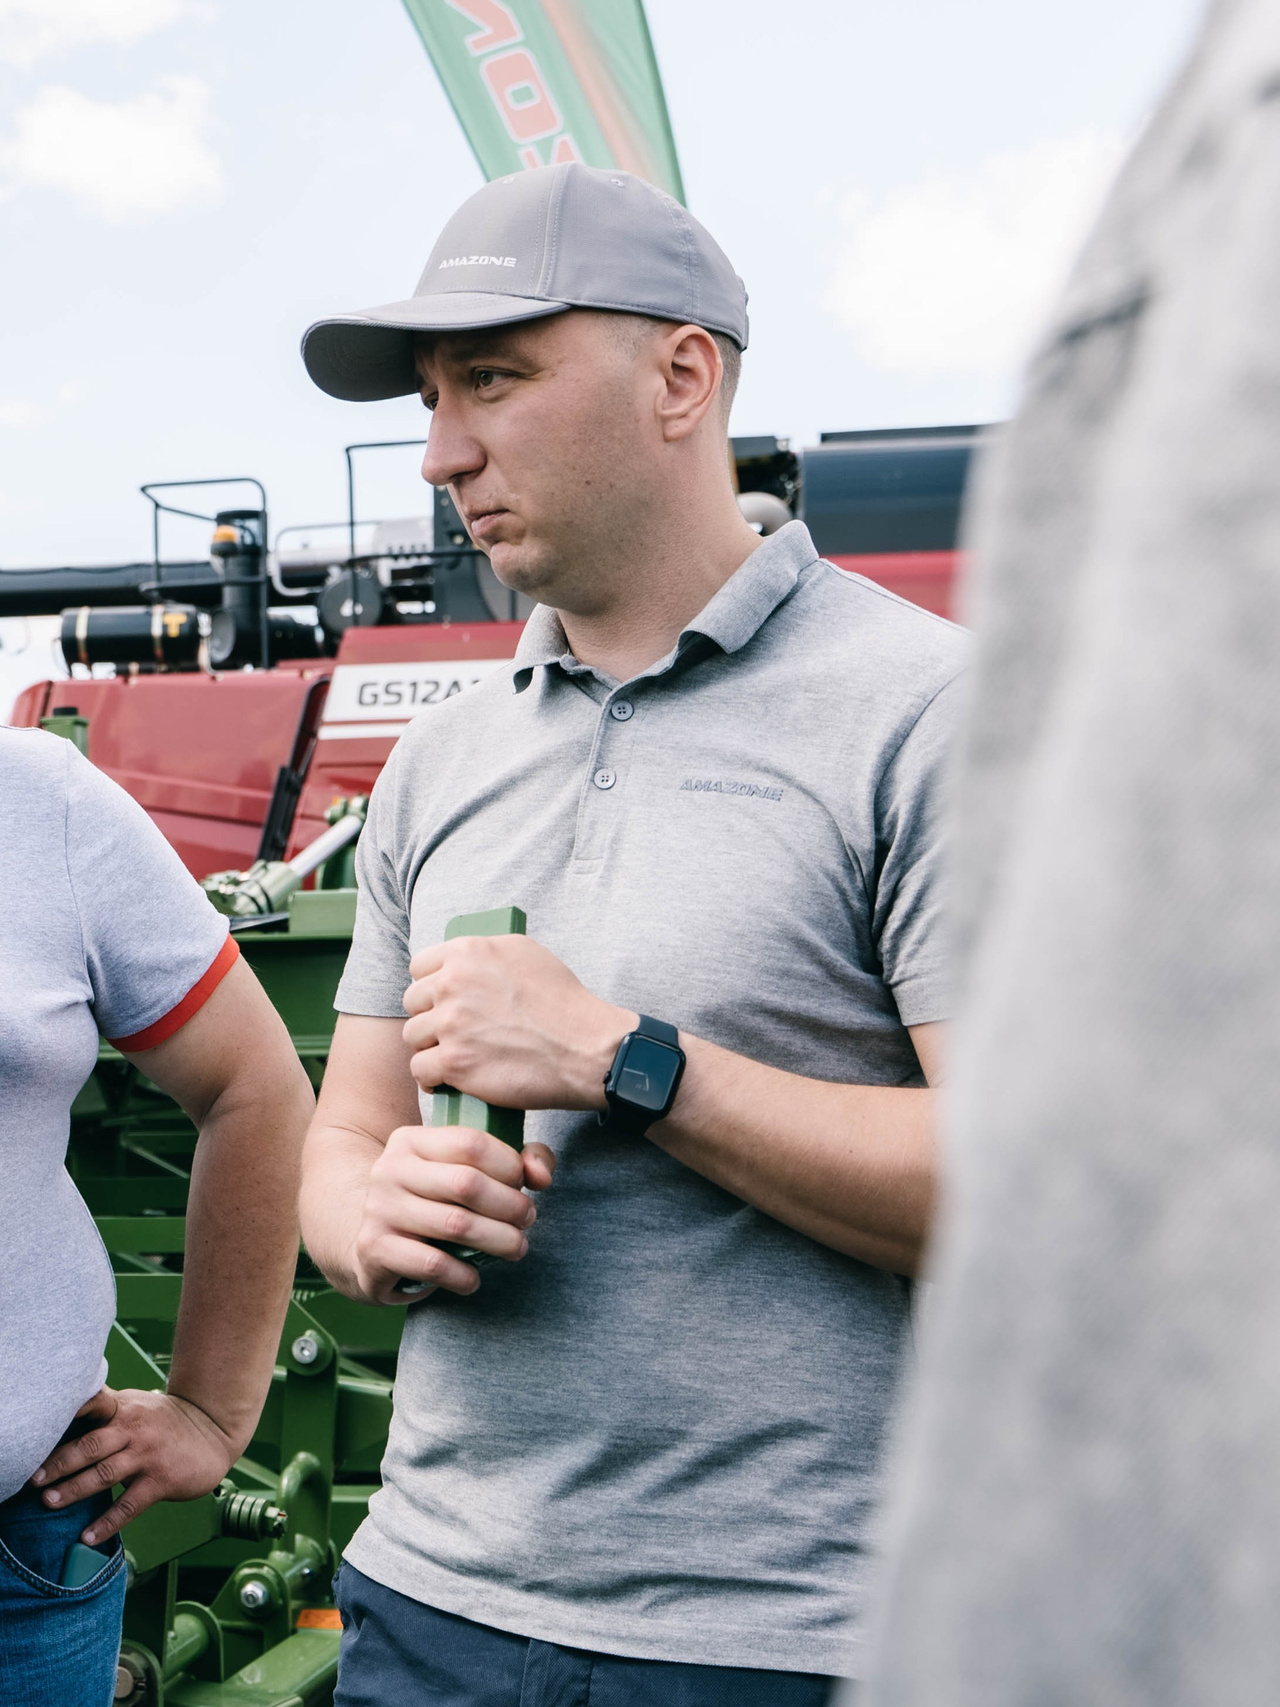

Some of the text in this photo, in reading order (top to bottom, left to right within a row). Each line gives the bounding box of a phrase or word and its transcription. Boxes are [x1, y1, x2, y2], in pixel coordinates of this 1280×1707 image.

[438, 255, 517, 270] AMAZONE
[357, 679, 481, 706] GS12A
[679, 778, 784, 802] AMAZONE
